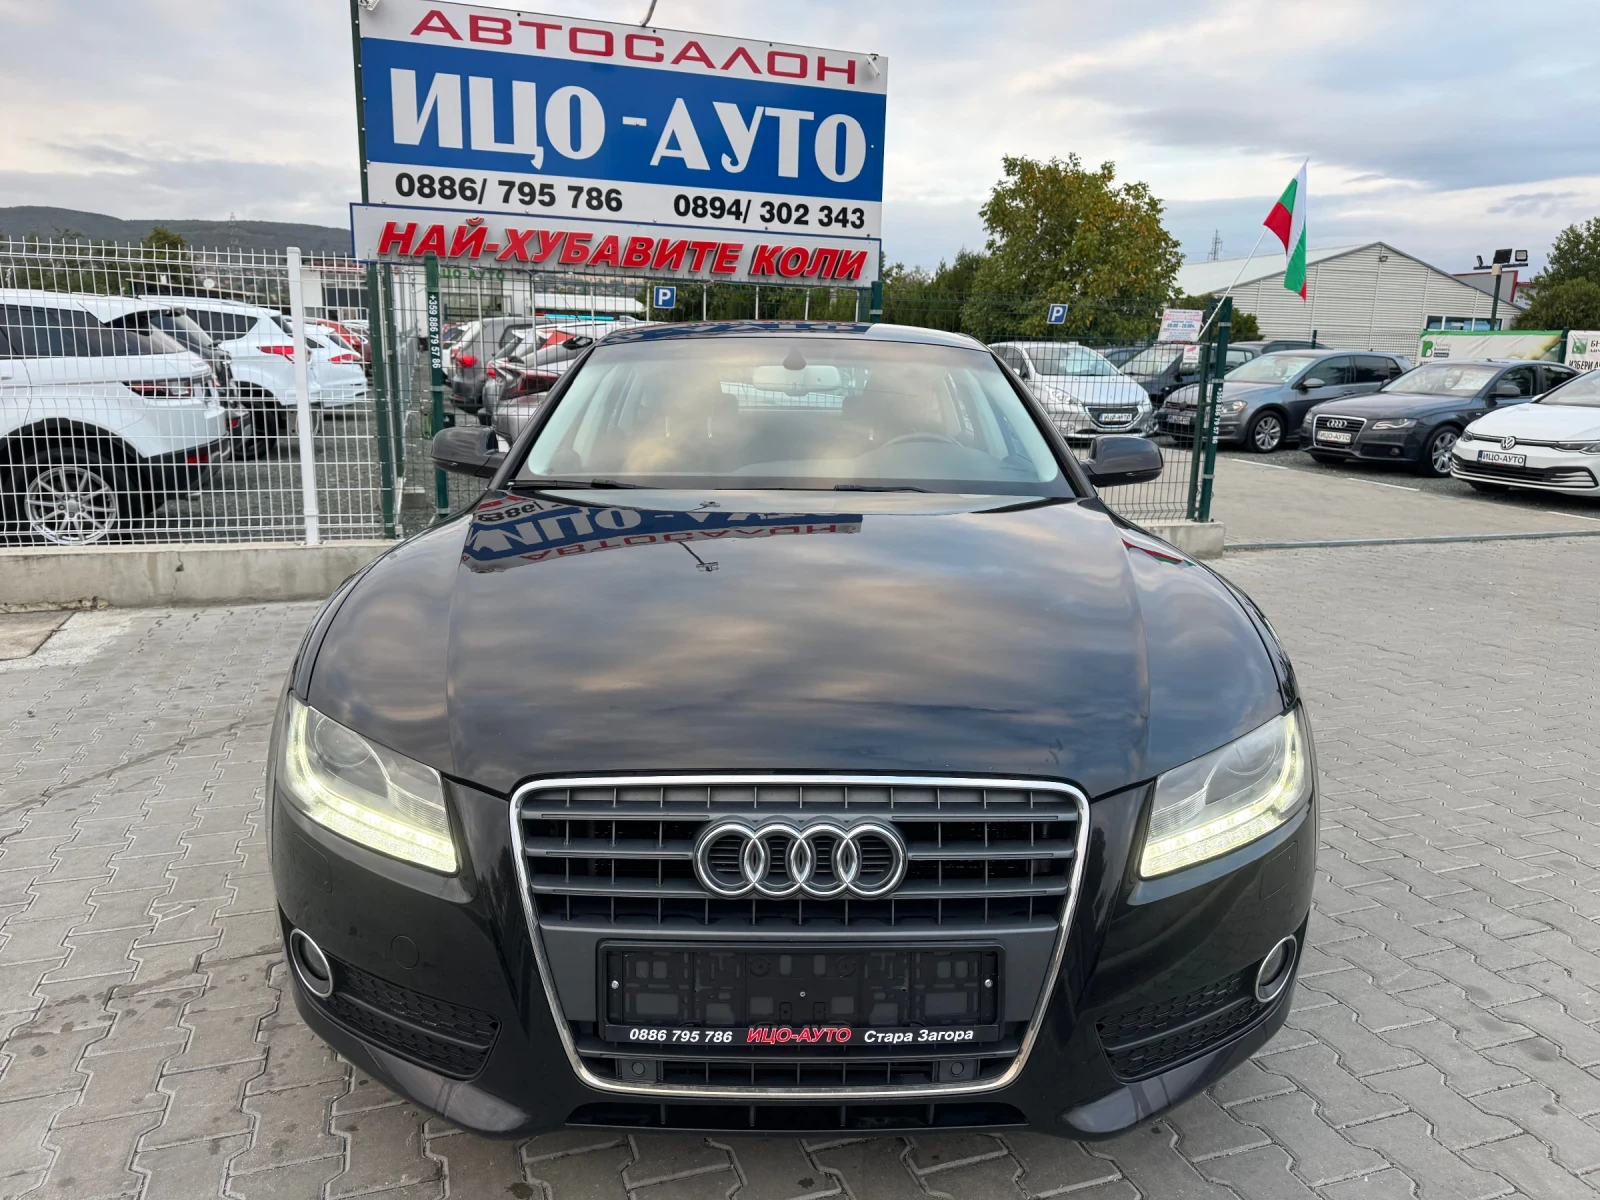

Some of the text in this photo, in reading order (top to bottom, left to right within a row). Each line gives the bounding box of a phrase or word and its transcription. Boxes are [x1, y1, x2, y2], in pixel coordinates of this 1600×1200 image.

[411, 9, 857, 85] АВТОСАЛОН
[395, 172, 865, 229] 0886/ 795 786 0894/ 302 343
[376, 216, 869, 281] НАЙ-ХУБАВИТЕ КОЛИ
[658, 288, 672, 306] P
[1052, 306, 1064, 321] P
[429, 316, 439, 333] 886
[430, 334, 439, 345] 79
[431, 346, 440, 357] 57
[432, 358, 441, 369] 86
[1482, 452, 1524, 464] ИЦО-АУТО
[629, 1028, 733, 1043] 0886 795 786
[747, 1027, 852, 1044] ИЦО-АУТО
[864, 1029, 974, 1044] Стара Загора
